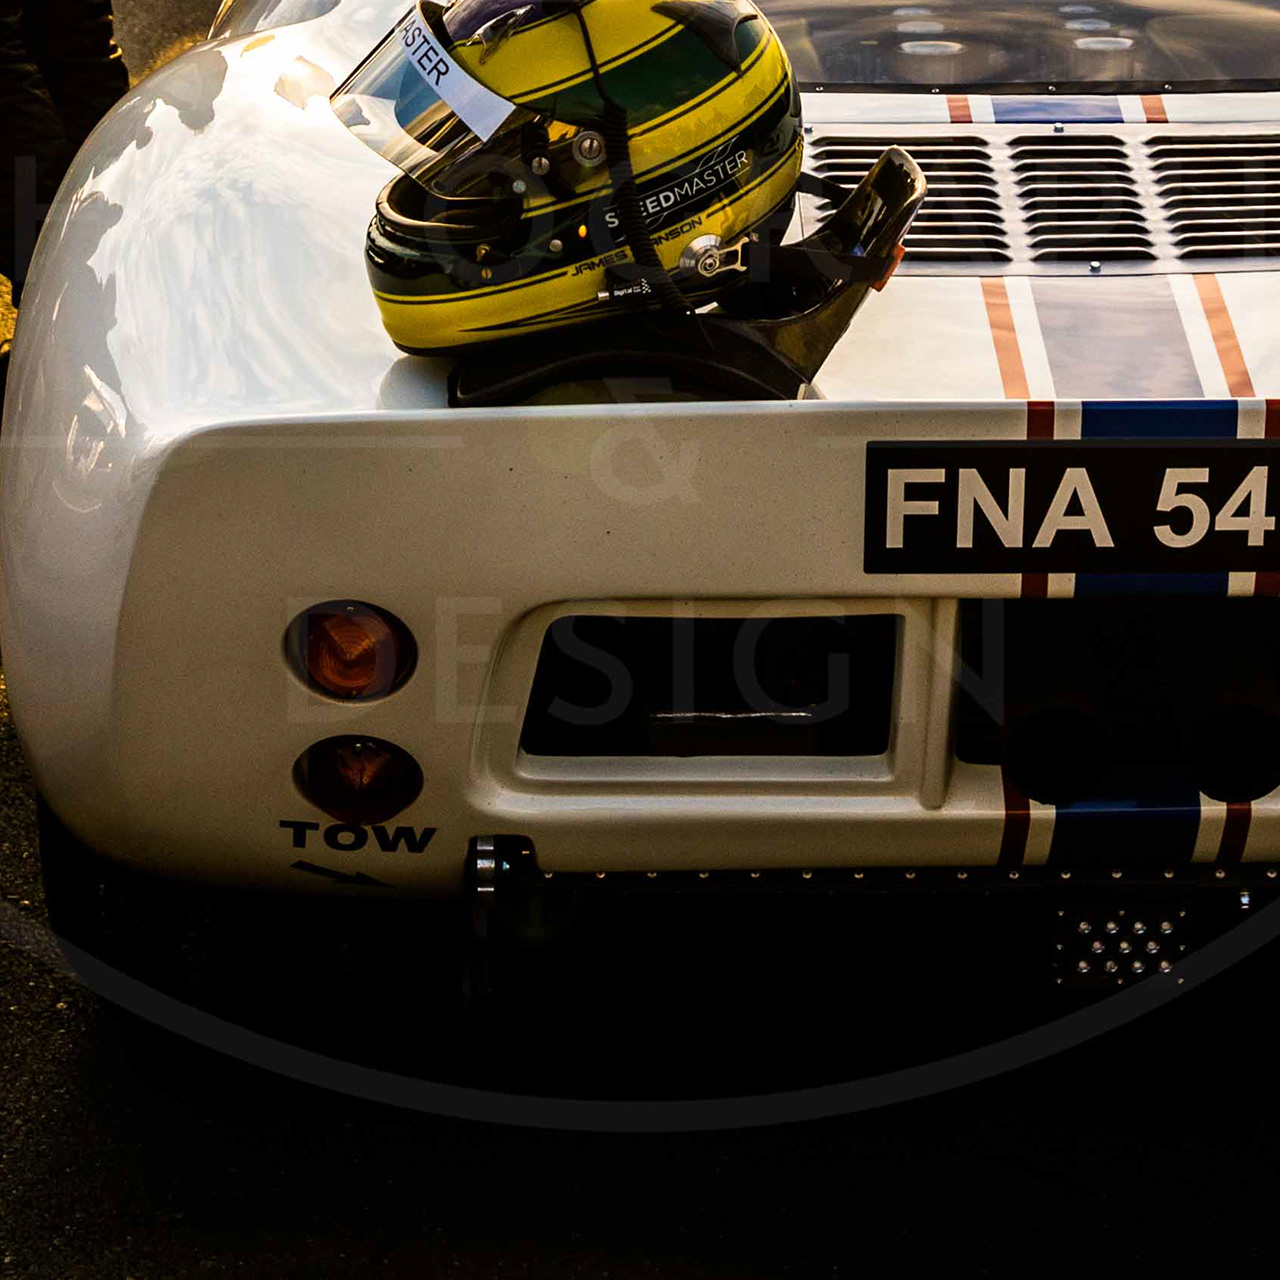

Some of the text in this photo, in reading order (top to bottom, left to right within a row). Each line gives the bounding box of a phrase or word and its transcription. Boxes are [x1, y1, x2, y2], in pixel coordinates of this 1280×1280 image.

[401, 19, 450, 87] ASTER
[605, 150, 748, 228] SEDMASTER
[572, 216, 704, 277] JAMES ANSON
[885, 467, 1115, 549] FNA
[279, 820, 437, 853] TOW
